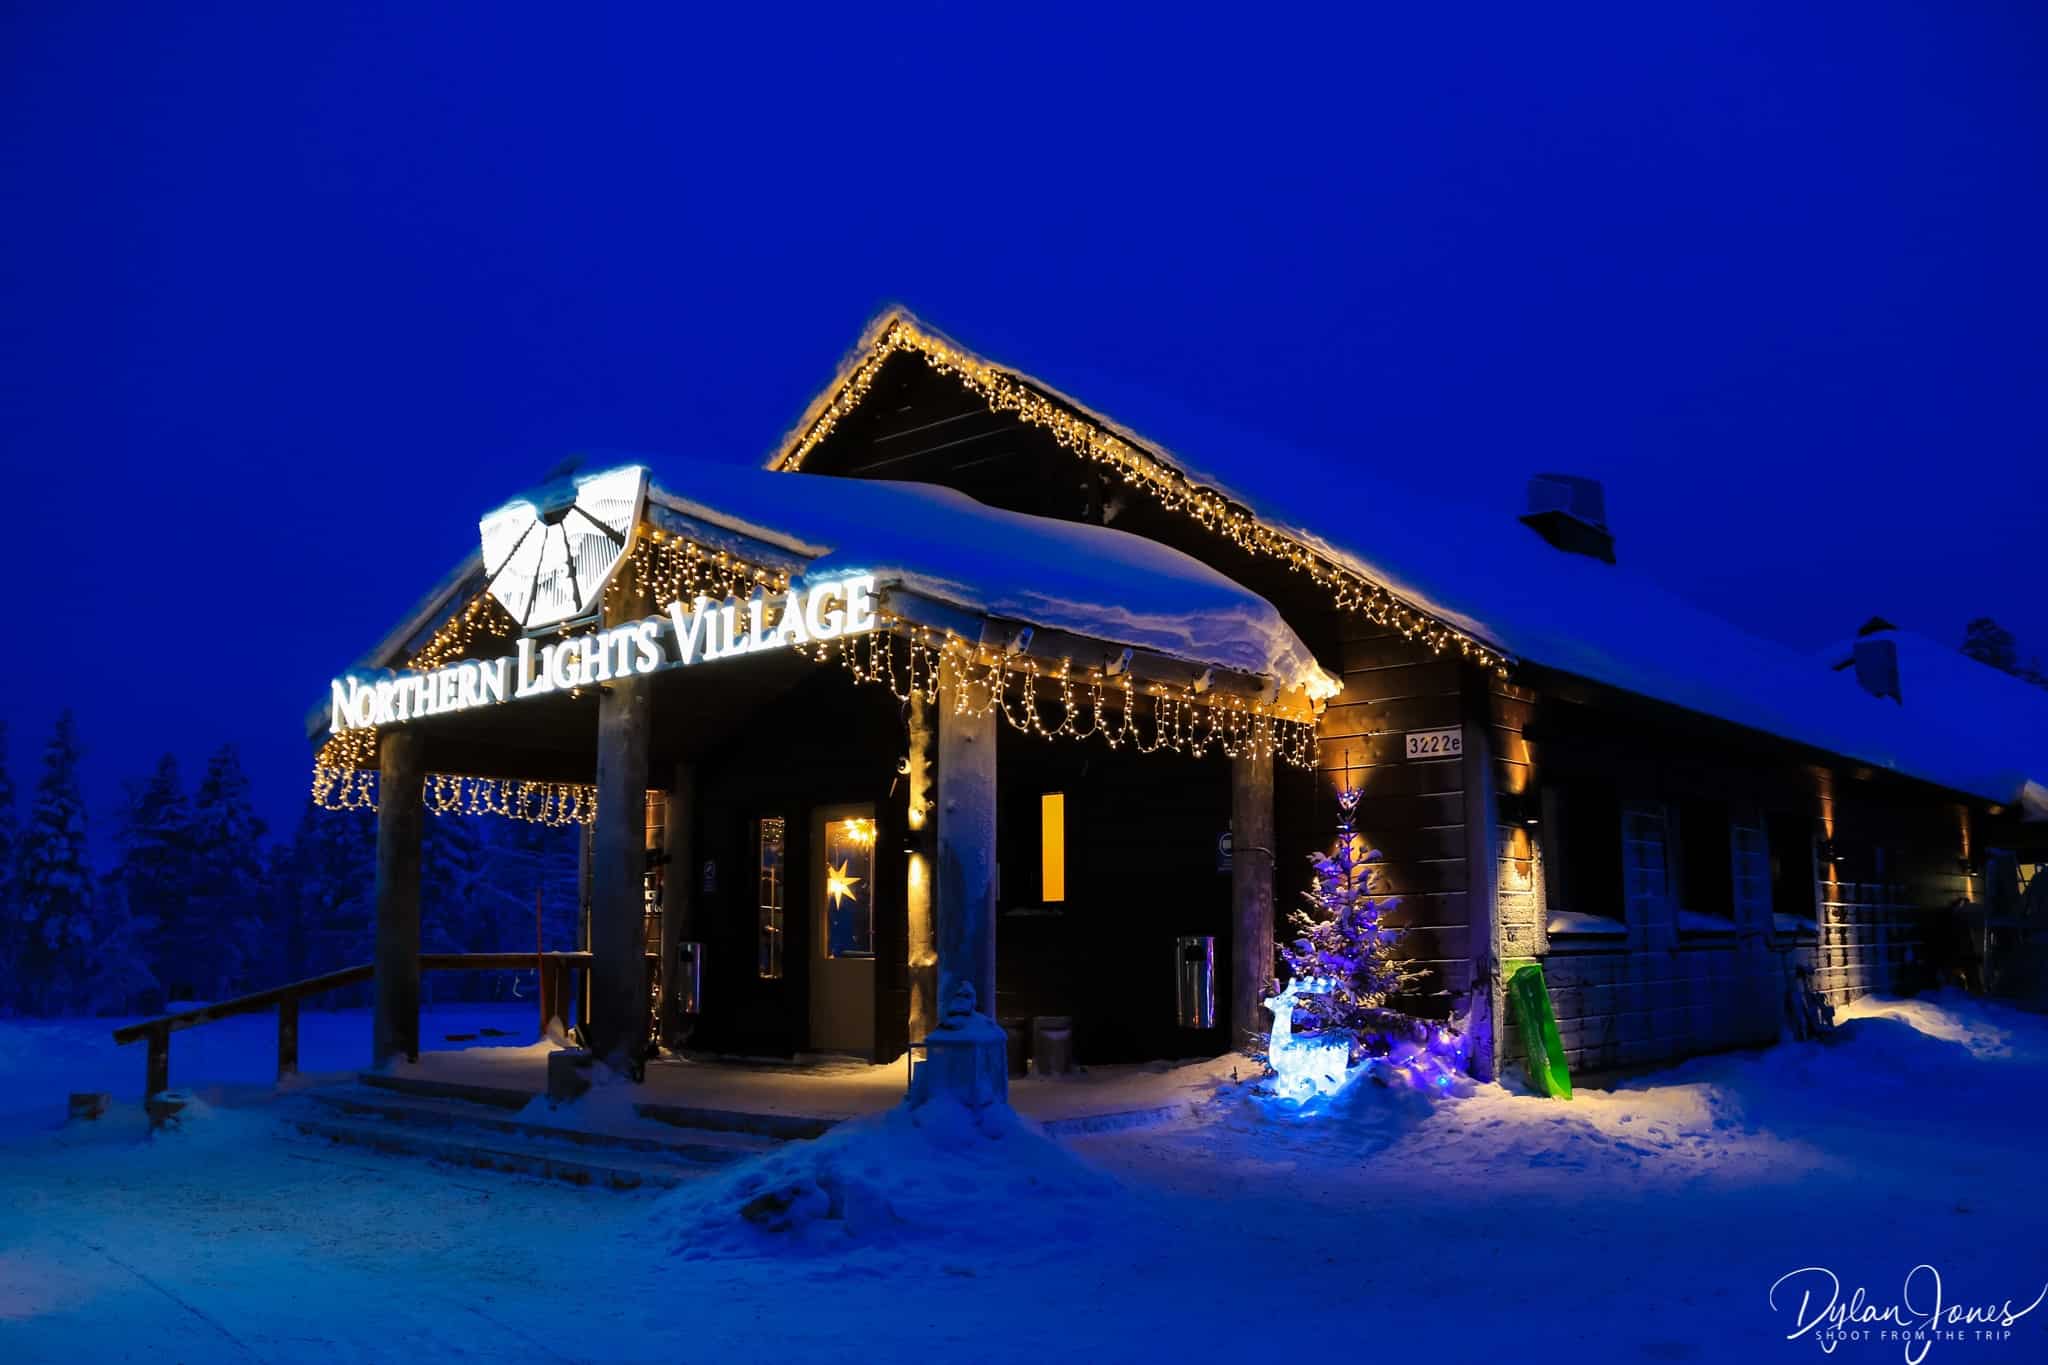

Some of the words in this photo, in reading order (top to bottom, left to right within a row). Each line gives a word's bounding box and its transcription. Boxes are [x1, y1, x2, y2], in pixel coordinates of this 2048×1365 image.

[329, 656, 512, 733] NORTHERN
[515, 621, 661, 698] LIGHTS
[667, 575, 877, 665] VILLAGE
[1410, 735, 1460, 754] 3222e
